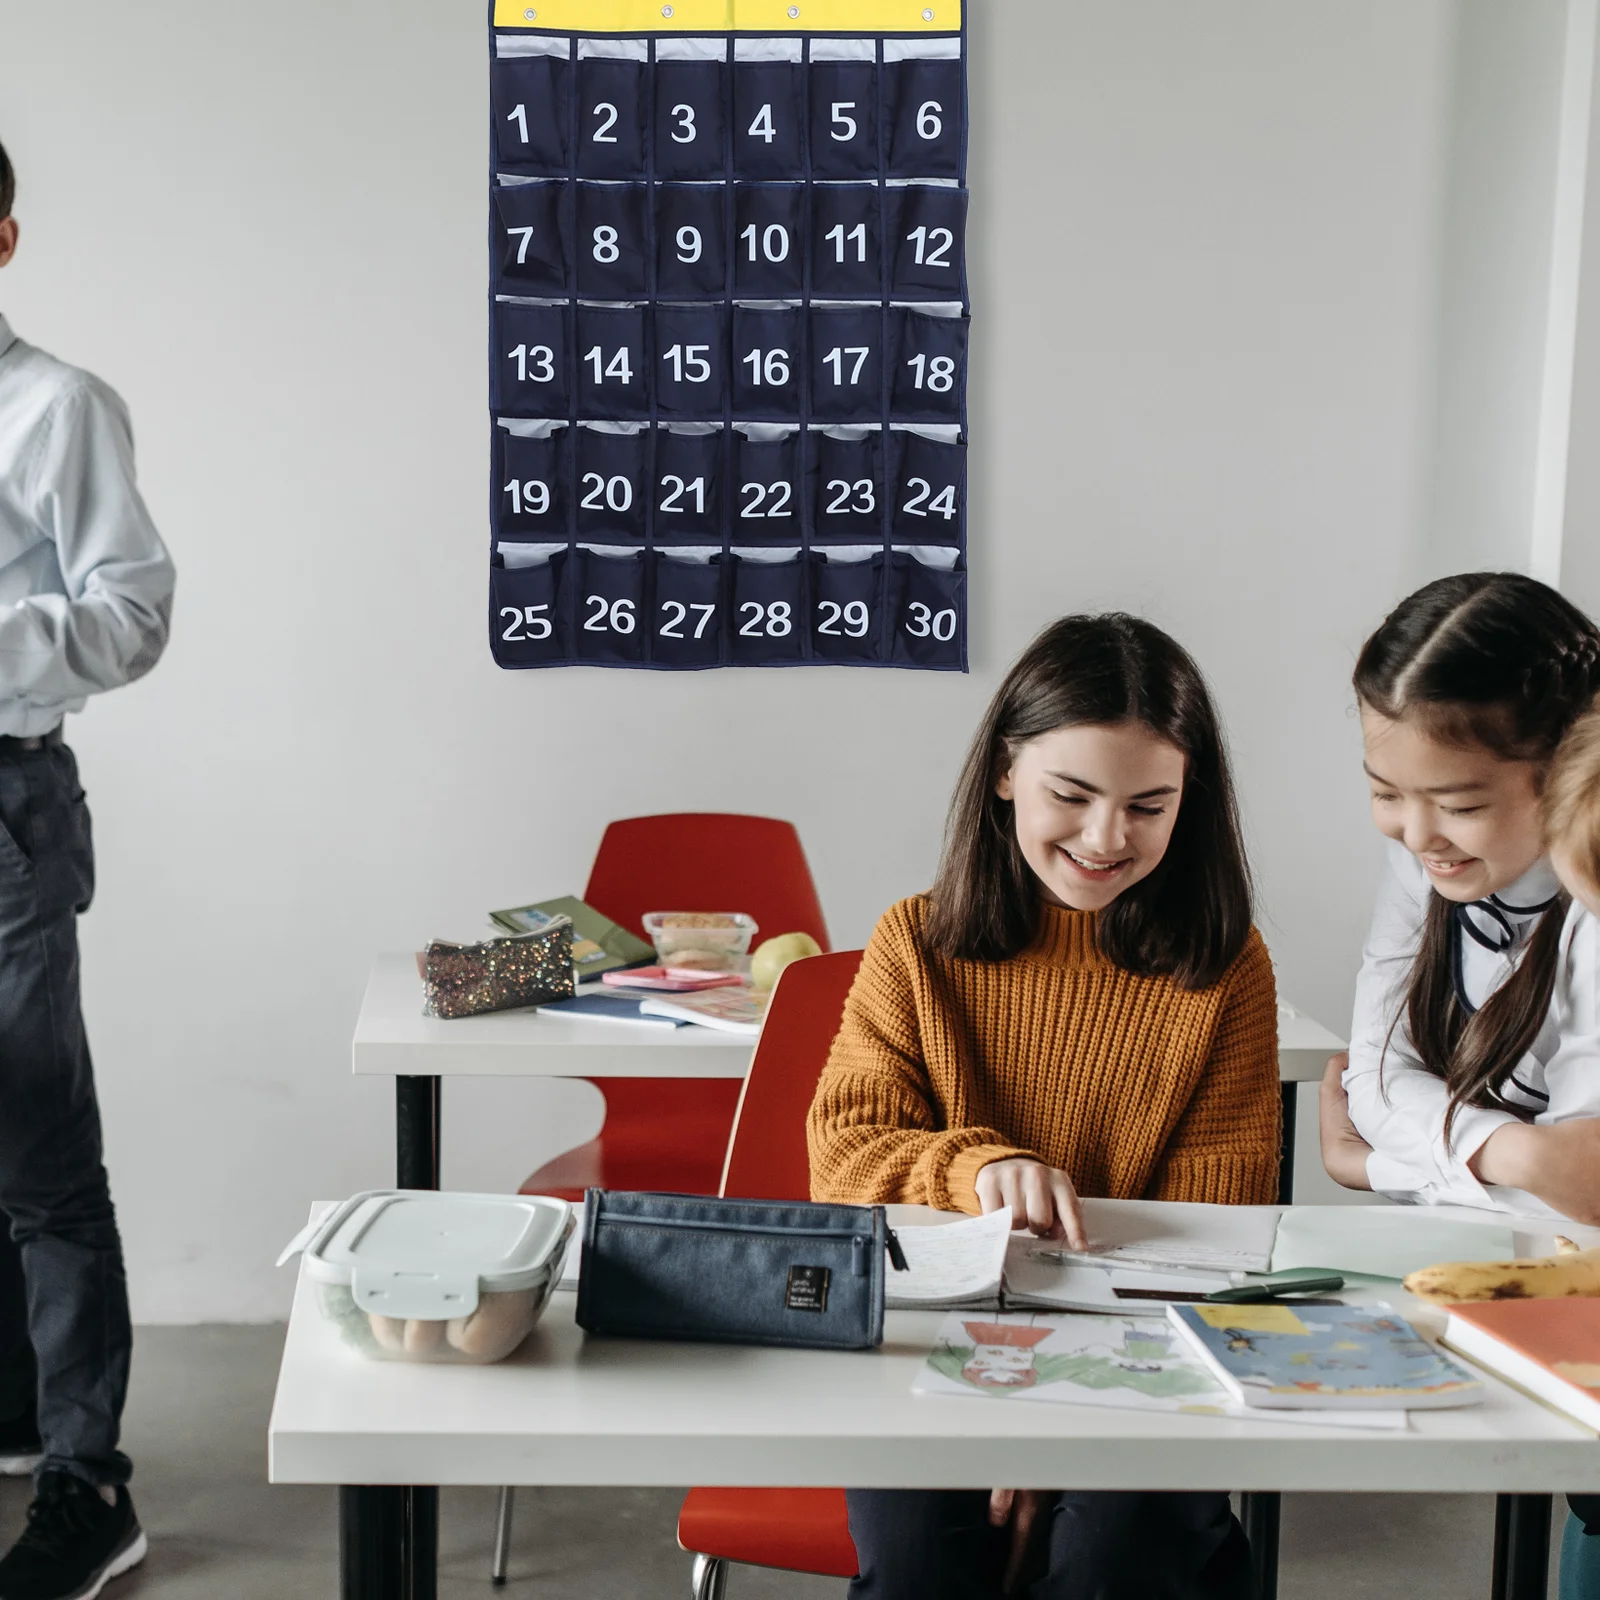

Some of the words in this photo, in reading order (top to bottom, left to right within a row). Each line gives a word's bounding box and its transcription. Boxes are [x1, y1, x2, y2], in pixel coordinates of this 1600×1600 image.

[507, 103, 529, 144] 1
[592, 102, 618, 143] 2
[671, 104, 697, 144] 3
[748, 103, 777, 143] 4
[830, 102, 857, 142] 5
[916, 100, 943, 140] 6
[507, 226, 534, 264] 7
[592, 225, 620, 263] 8
[675, 225, 702, 263] 9
[740, 223, 789, 263] 10
[824, 223, 866, 263] 11
[906, 225, 954, 268] 12
[507, 343, 555, 383] 13
[584, 345, 634, 385] 14
[663, 344, 711, 383] 15
[742, 348, 790, 386] 16
[822, 346, 870, 386] 17
[907, 353, 955, 392] 18
[503, 478, 550, 514] 19
[580, 472, 633, 512] 20
[659, 474, 704, 513] 21
[740, 481, 792, 518] 22
[826, 478, 875, 514] 23
[902, 477, 957, 520] 24
[500, 603, 552, 641] 25
[583, 595, 636, 634] 26
[659, 600, 716, 639] 27
[739, 600, 792, 637] 28
[817, 600, 869, 638] 29
[905, 601, 957, 641] 30
